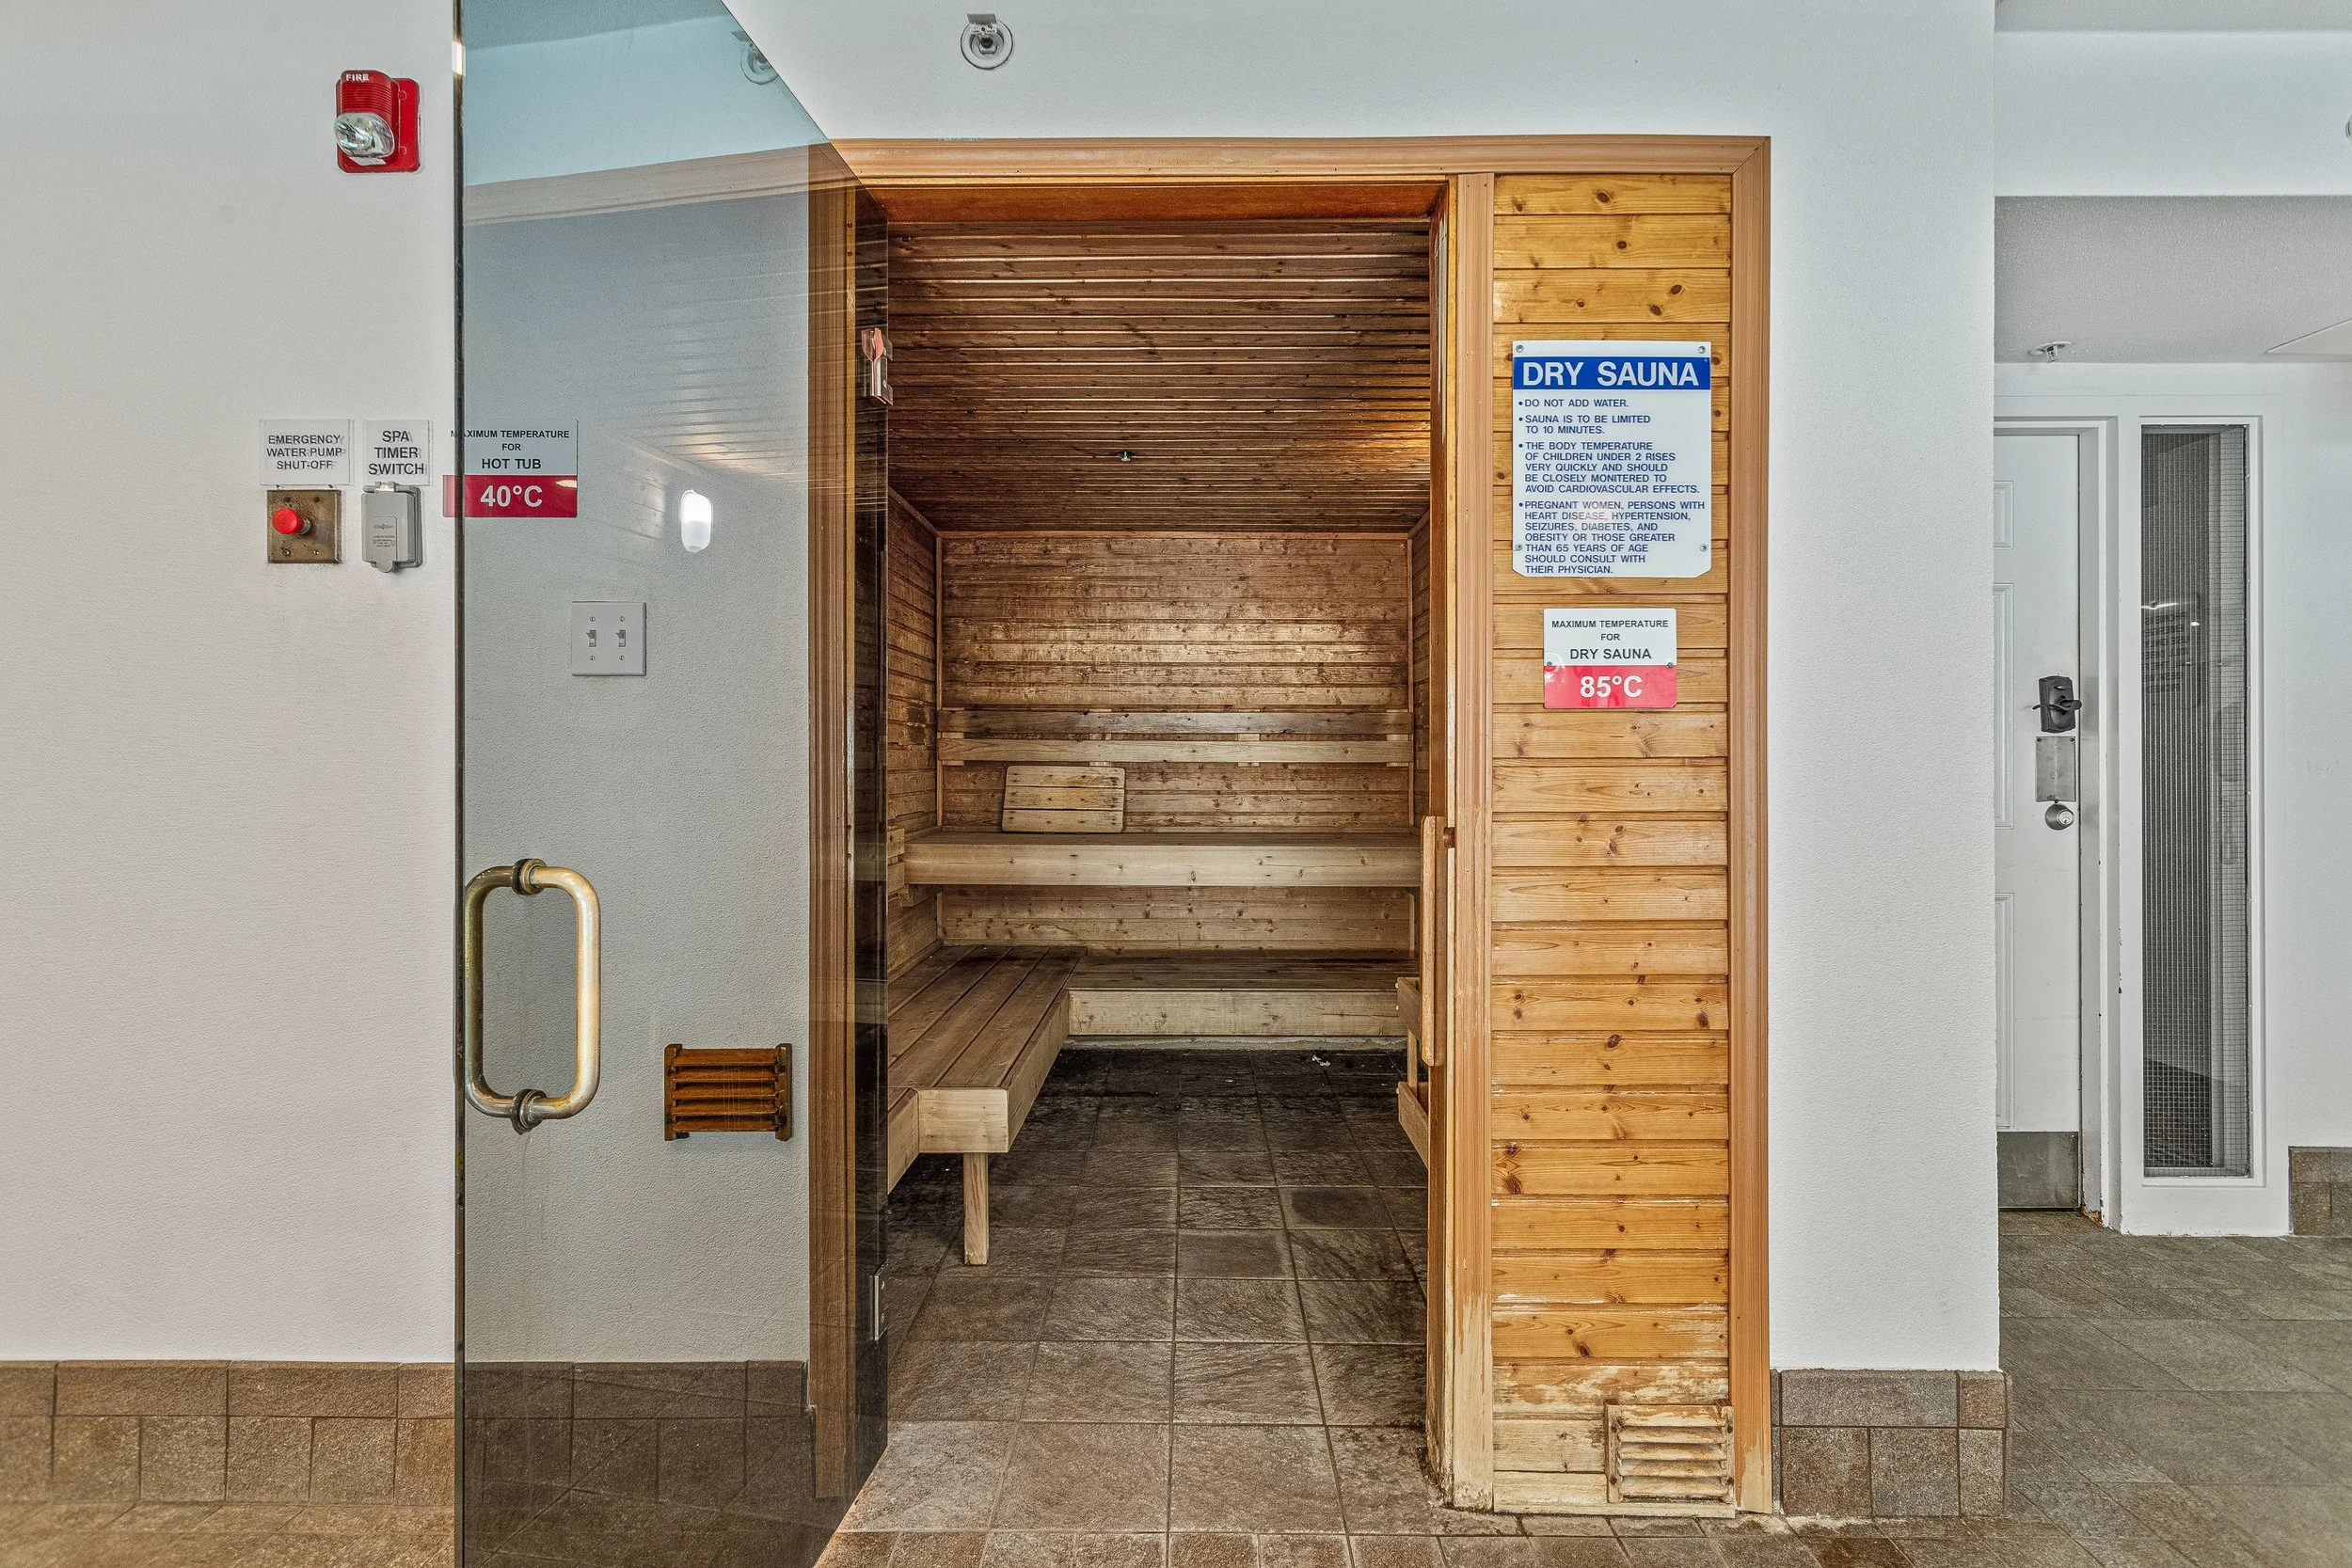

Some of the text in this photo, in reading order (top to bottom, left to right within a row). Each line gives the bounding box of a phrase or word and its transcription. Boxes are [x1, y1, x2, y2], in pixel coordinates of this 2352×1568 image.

[345, 73, 370, 83] FIRE
[1522, 361, 1699, 387] DRY SAUNA
[1524, 399, 1629, 408] DO NOT ADD WATER.
[1525, 415, 1651, 424] SAUNA IS TO BE LIMITED
[501, 430, 570, 438] TEMPERATURE
[1525, 425, 1605, 435] TO 10 MINUTES.
[268, 435, 341, 445] EMERGENCY
[382, 430, 410, 443] SPA
[501, 443, 522, 451] FOR
[1525, 441, 1653, 451] THE BODY TEMPERATURE
[266, 447, 342, 457] WATER PUMP
[373, 446, 419, 459] TIMER
[1525, 452, 1677, 462] OF CHILDREN UNDER 2 RISES
[277, 460, 333, 469] SHUT-OFF
[482, 458, 542, 469] HOT TUB
[1525, 463, 1668, 473] VERY QUICKLY AND SHOULD
[368, 462, 424, 476] SWITCH
[1525, 473, 1667, 483] BE CLOSELY MONITERED TO
[1525, 484, 1700, 494] AVOID CARDIOVASCULAR EFFECTS.
[480, 484, 543, 508] 40°C
[1524, 500, 1706, 511] PREGNANT WOMEN, PERSONS WITH
[1525, 512, 1691, 521] HEART DISEASE, HYPERTENSION,
[1525, 522, 1659, 531] SEIZURES, DIABETES, AND
[1525, 533, 1676, 542] OBESITY OR THOSE GREATER
[1525, 544, 1649, 553] THAN 65 YEARS OF AGE
[1525, 554, 1645, 563] SHOULD CONSULT WITH
[1525, 565, 1613, 575] THEIR PHYSICIAN.
[1551, 620, 1669, 628] MAXIMUM TEMPERATURE
[1569, 648, 1652, 659] DRY SAUNA
[1580, 675, 1643, 698] 85°C
